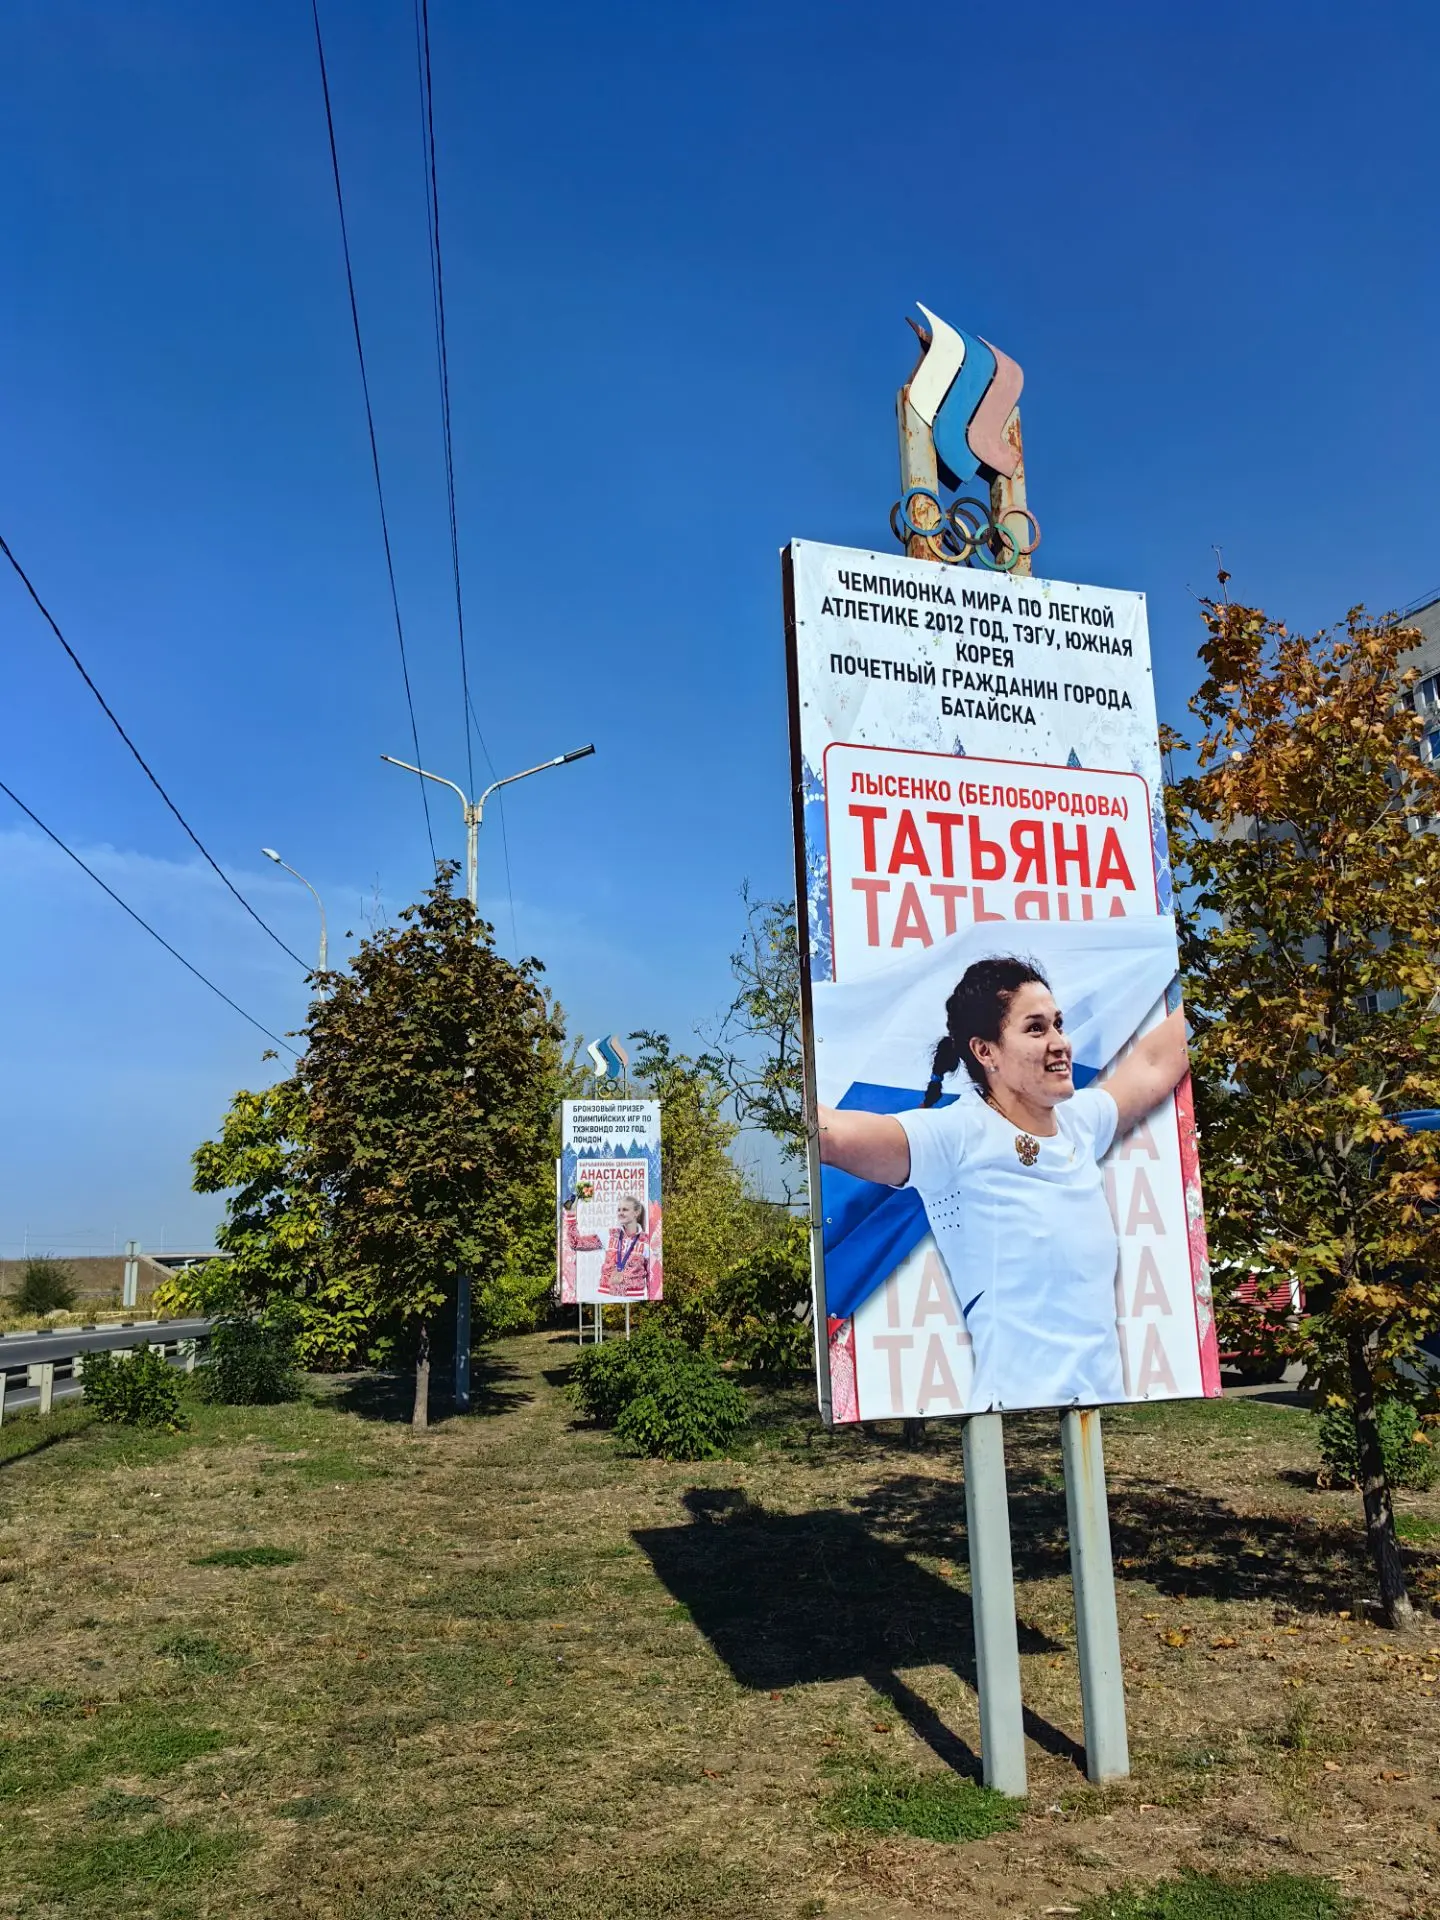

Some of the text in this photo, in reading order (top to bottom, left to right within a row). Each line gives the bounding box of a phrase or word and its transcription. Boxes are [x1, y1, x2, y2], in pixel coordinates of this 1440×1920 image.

[837, 570, 1115, 629] ЧЕМПИОНКА МИРА ПО ЛЕГКОЙ
[821, 596, 1133, 657] АТЛЕТИКЕ 2012 ГОД, ТЭГУ, ЮЖНАЯ
[956, 642, 1015, 668] КОРЕЯ
[830, 653, 1133, 711] ПОЧЕТНЫЙ ГРАЖДАНИН ГОРОДА
[941, 695, 1036, 726] БАТАЙСКА
[850, 771, 1129, 821] ЛЫСЕНКО (БЕЛОБОРОДОВА)
[848, 804, 1137, 891] ТАТЬЯНА
[573, 1104, 645, 1112] БРОНЗОВЫЙ ПРИЗЕР
[573, 1114, 626, 1122] ОЛИМПИЙСКИХ
[573, 1125, 647, 1133] ТХЭКВОНДО 2012 ГОД,
[573, 1136, 602, 1144] ЛОНДОН
[580, 1168, 645, 1180] АНАСТАСИЯ
